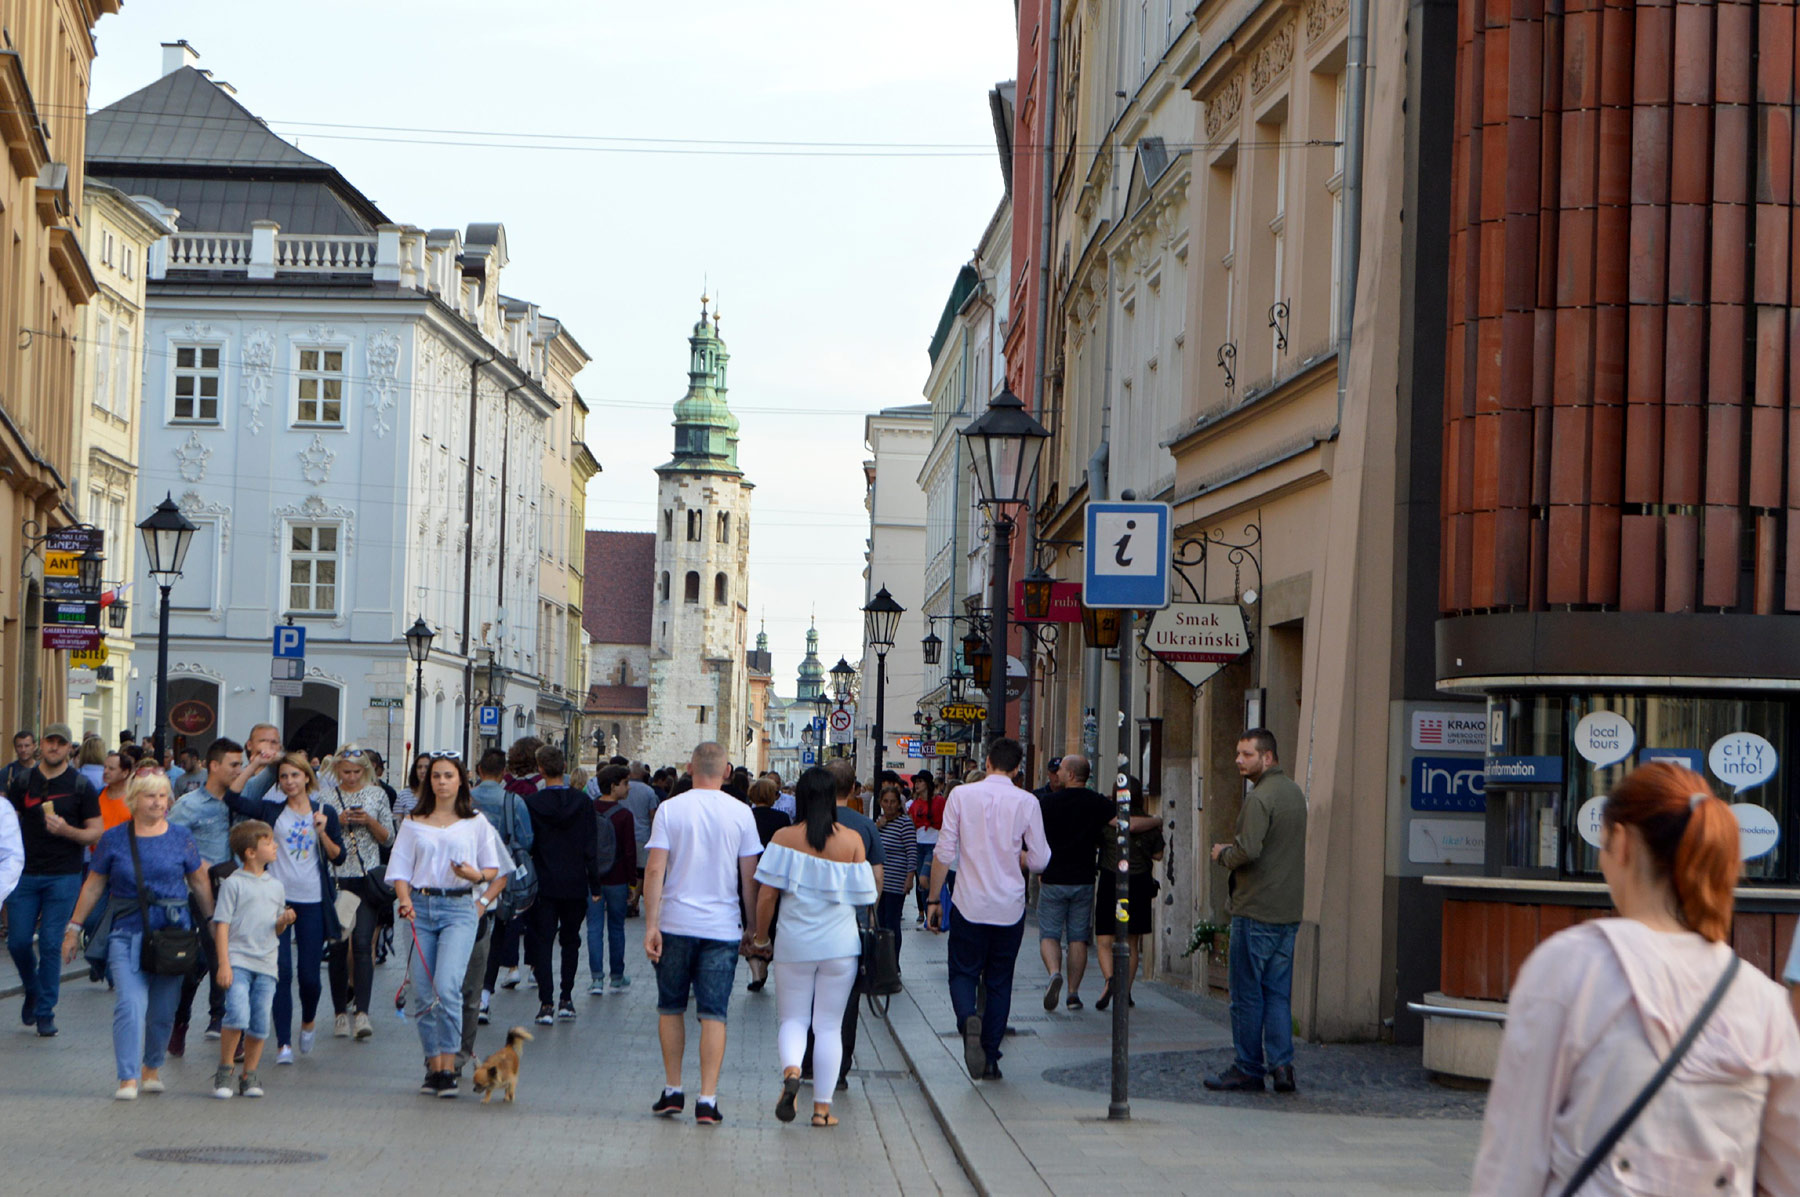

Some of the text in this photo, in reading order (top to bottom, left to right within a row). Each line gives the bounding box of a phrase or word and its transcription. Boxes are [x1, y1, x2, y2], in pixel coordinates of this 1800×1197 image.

[49, 558, 76, 569] ANT
[1176, 612, 1219, 626] Smak
[279, 628, 299, 655] P
[1156, 631, 1240, 647] Ukraiński
[69, 648, 105, 659] OSTEL
[1164, 652, 1228, 661] RESTAURACJA
[483, 708, 495, 724] P
[941, 706, 986, 720] SZEWC
[1447, 720, 1486, 730] KRAKO
[1589, 724, 1619, 737] local
[1589, 739, 1619, 749] tours
[1723, 740, 1764, 759] city
[804, 752, 812, 763] P
[1724, 757, 1762, 774] info!
[1421, 798, 1487, 807] KRAKÓ
[1740, 827, 1776, 835] modation
